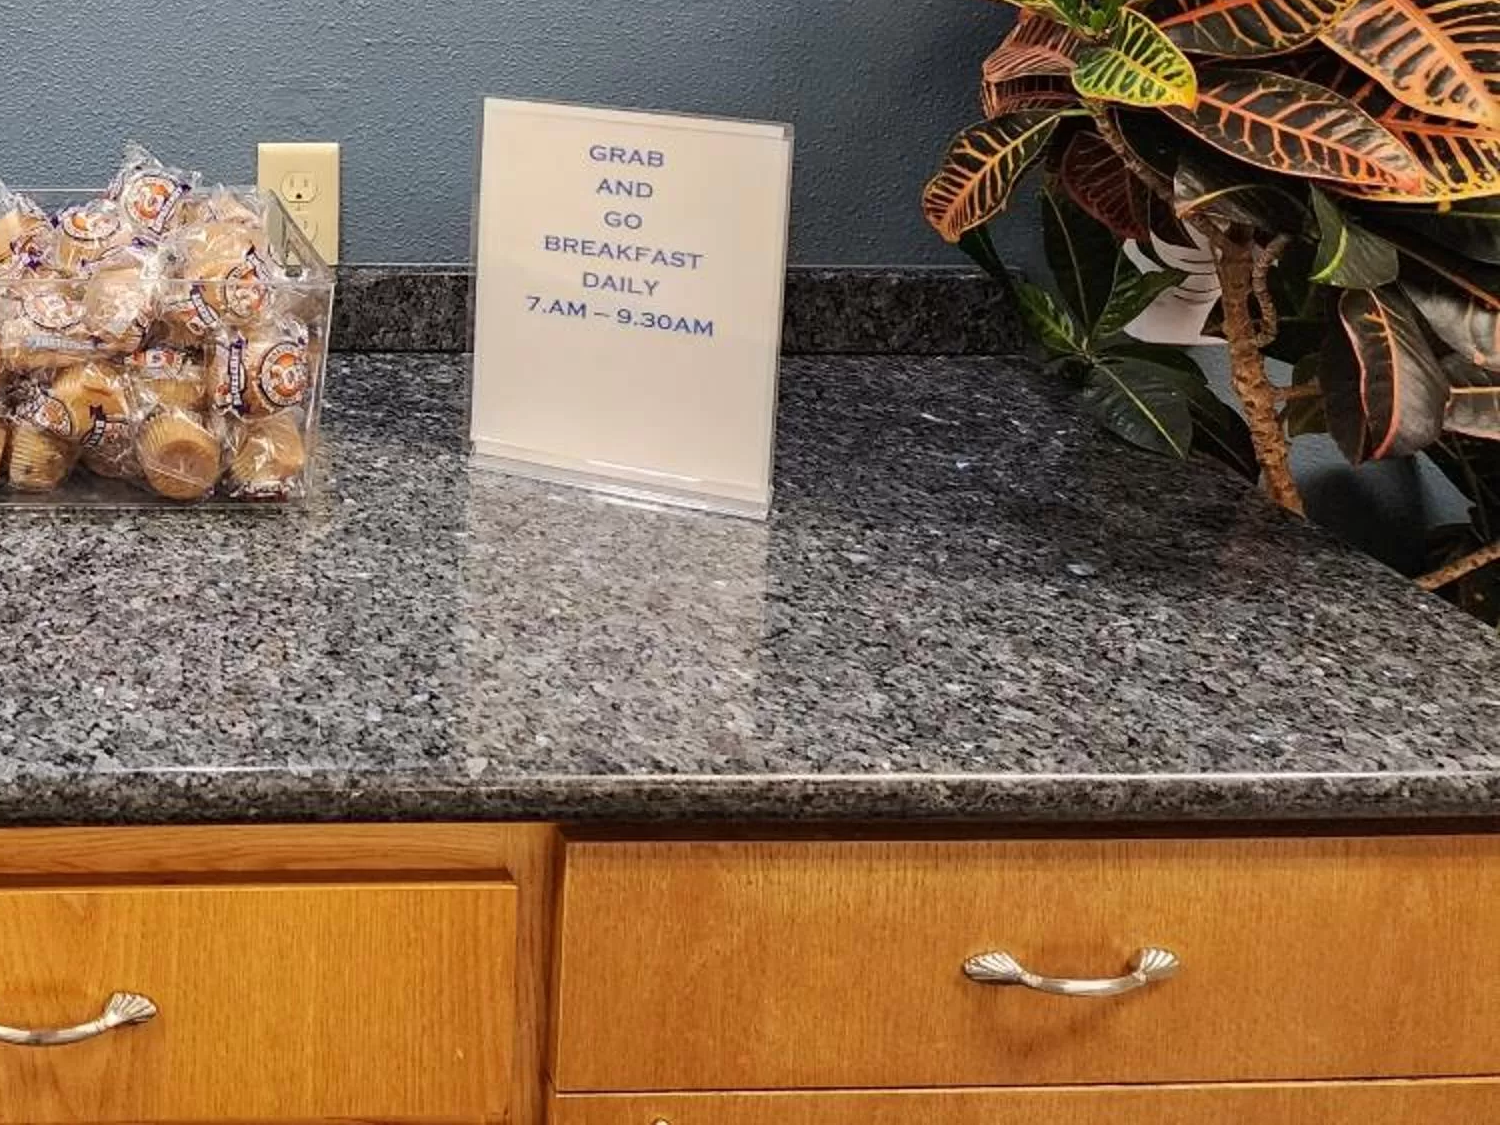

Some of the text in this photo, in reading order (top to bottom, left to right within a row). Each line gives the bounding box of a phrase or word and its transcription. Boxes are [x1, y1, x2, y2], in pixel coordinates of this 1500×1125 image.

[589, 144, 665, 168] GRAB
[596, 178, 654, 198] AND
[603, 210, 644, 231] GO
[544, 234, 706, 270] BREAKFAST
[582, 271, 660, 297] DAILY
[525, 295, 588, 319] 7.AM
[616, 308, 714, 337] 9.30AM
